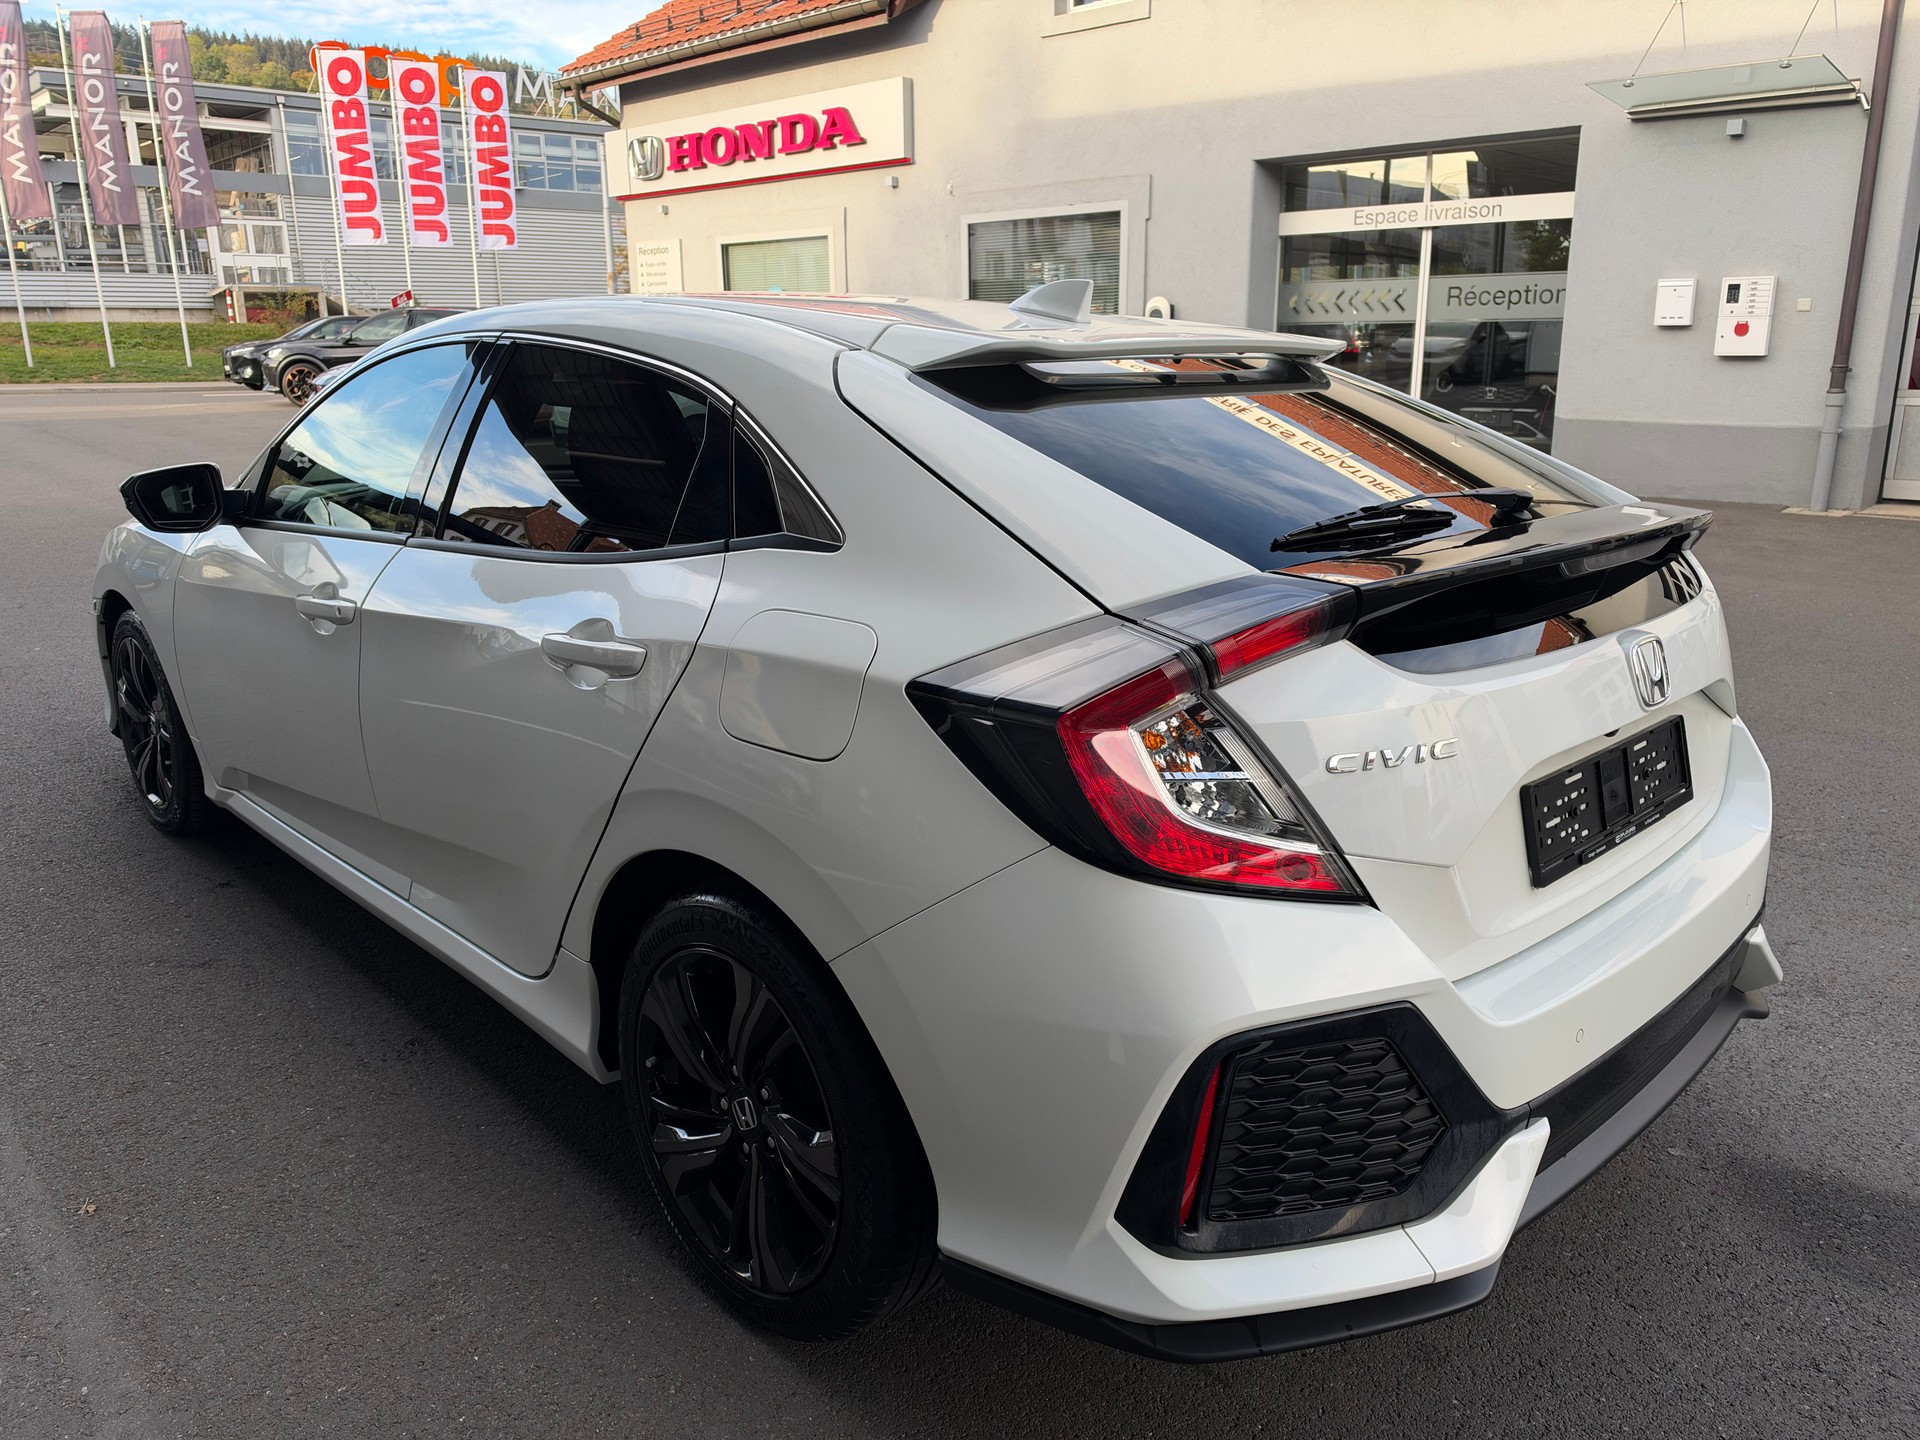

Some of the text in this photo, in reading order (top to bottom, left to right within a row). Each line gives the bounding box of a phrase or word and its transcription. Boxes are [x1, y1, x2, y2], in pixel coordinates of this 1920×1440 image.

[82, 52, 121, 193] MANOR
[162, 61, 203, 196] MANOR
[309, 40, 476, 107] op
[665, 106, 866, 172] HONDA
[327, 56, 382, 240] JUMBO
[399, 67, 449, 242] JUMBO
[471, 75, 515, 246] JUMBO
[1353, 202, 1503, 228] Espace livraison
[1325, 736, 1459, 775] CIVIC
